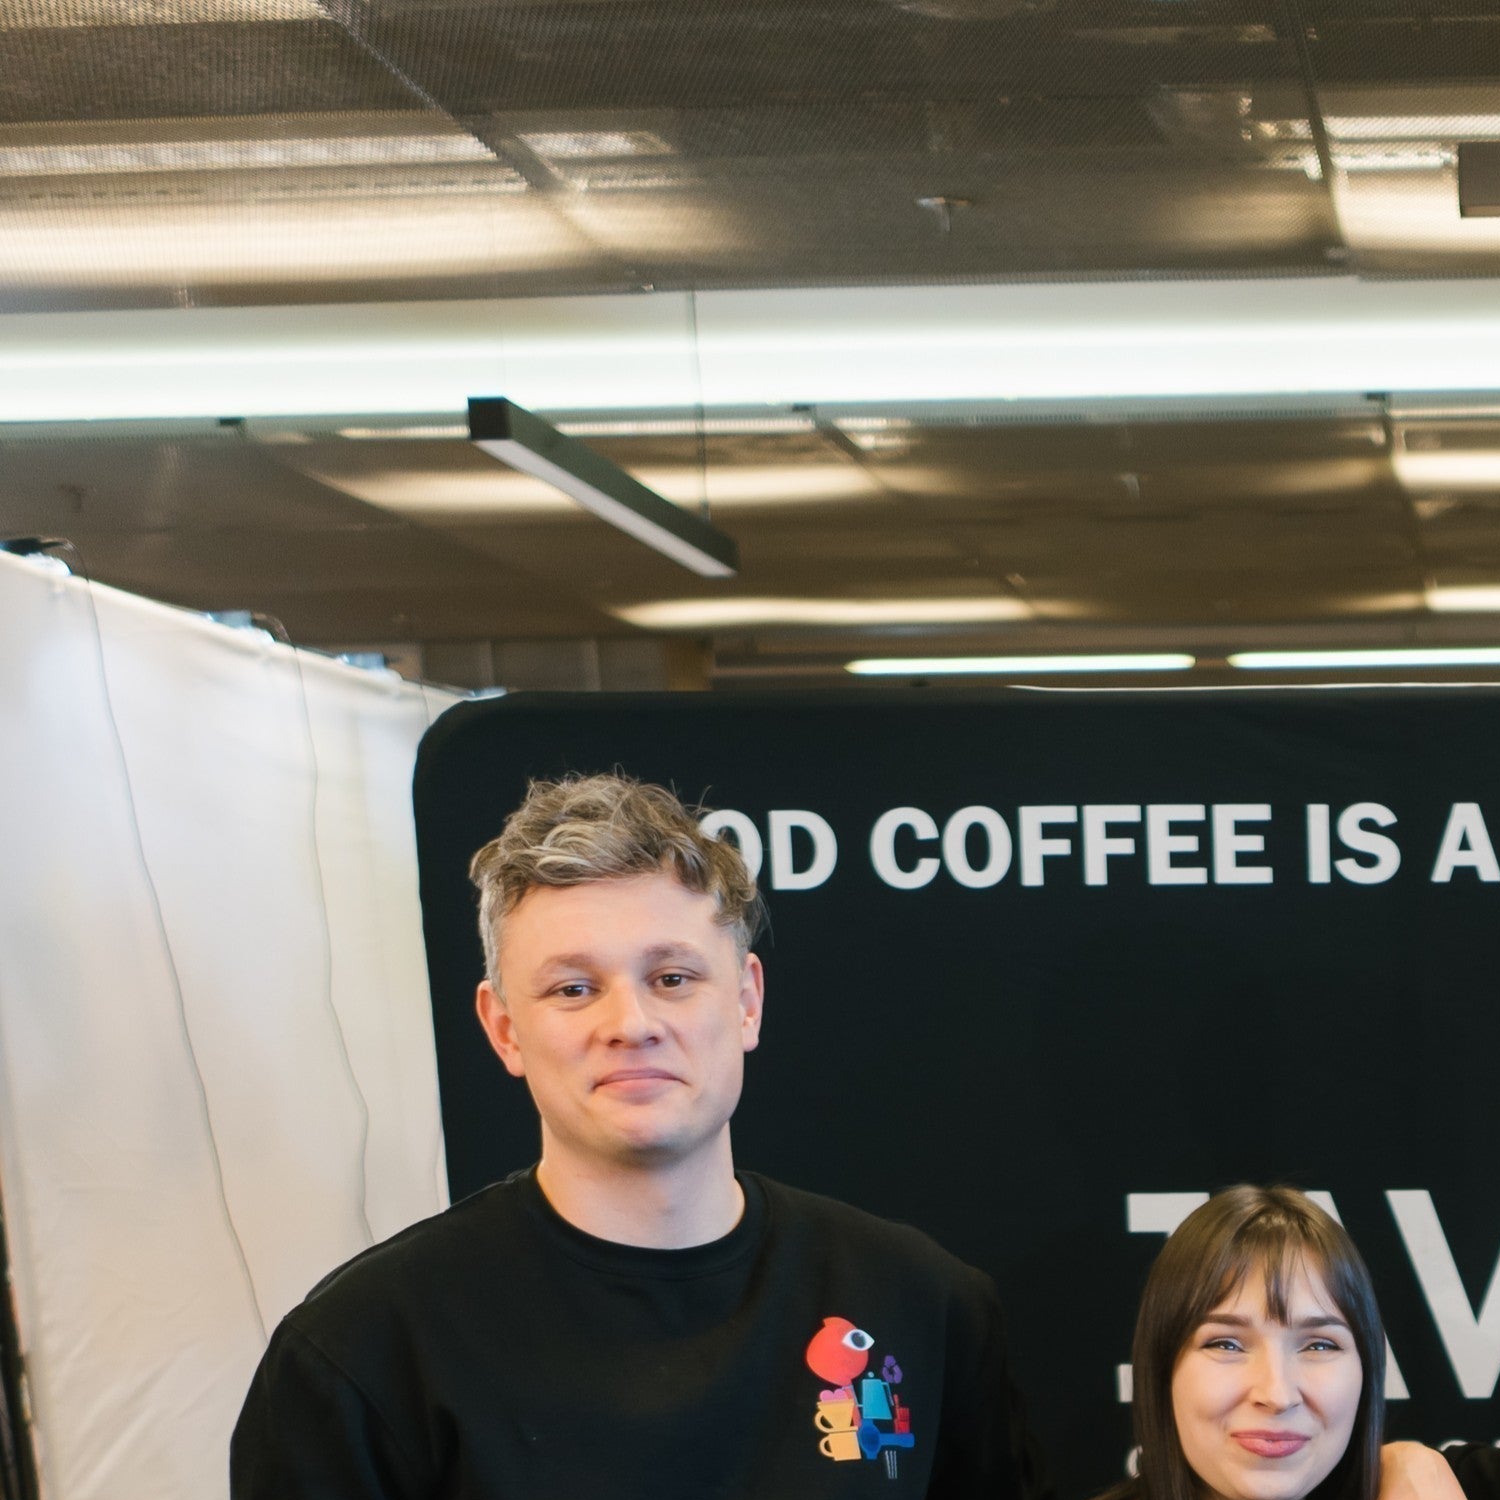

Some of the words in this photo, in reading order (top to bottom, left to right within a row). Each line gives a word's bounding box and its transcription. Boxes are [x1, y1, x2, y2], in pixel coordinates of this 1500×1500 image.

[699, 809, 839, 890] OD
[870, 804, 1274, 889] COFFEE
[1307, 802, 1401, 885] IS
